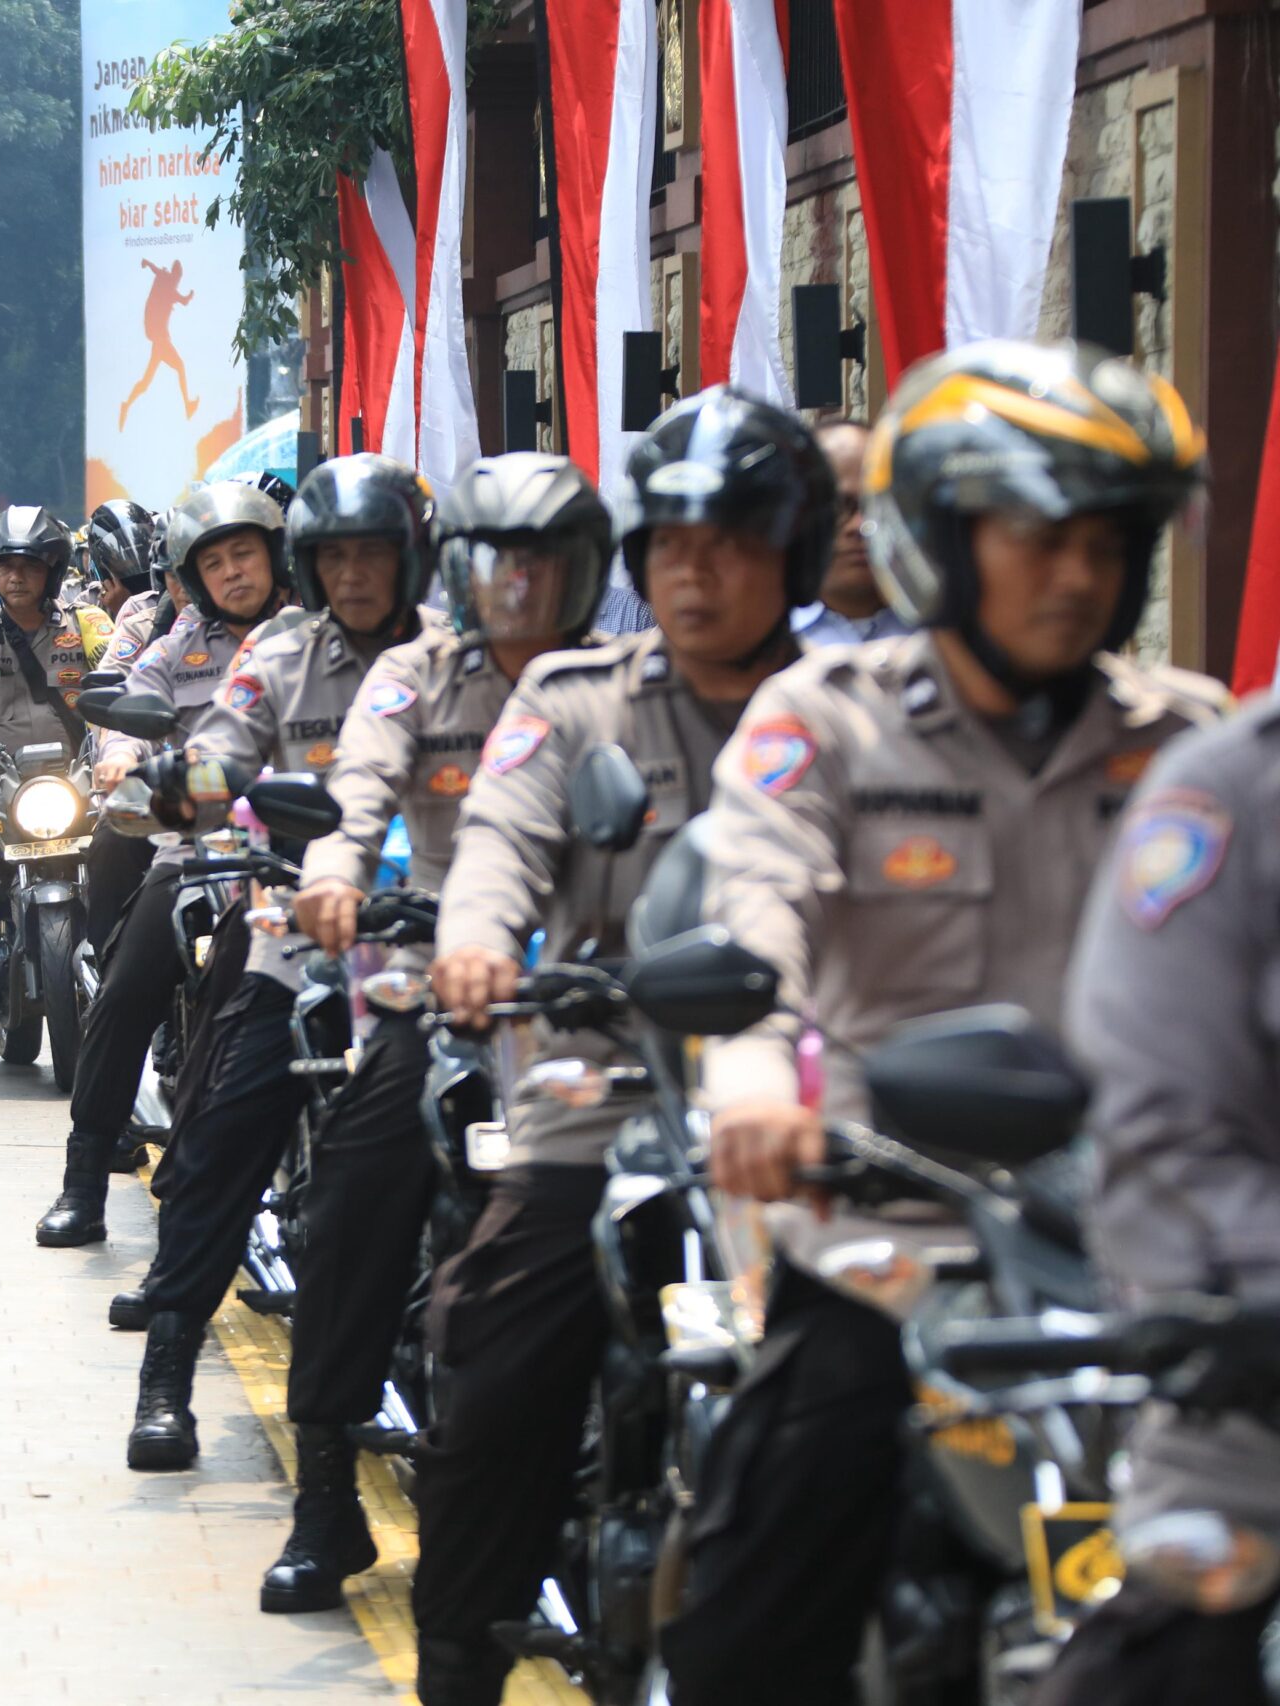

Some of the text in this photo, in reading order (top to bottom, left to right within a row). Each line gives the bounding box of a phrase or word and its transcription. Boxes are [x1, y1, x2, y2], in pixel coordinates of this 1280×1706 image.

[94, 56, 146, 90] Jangan
[99, 147, 152, 188] hindari
[119, 192, 199, 230] biar sehat
